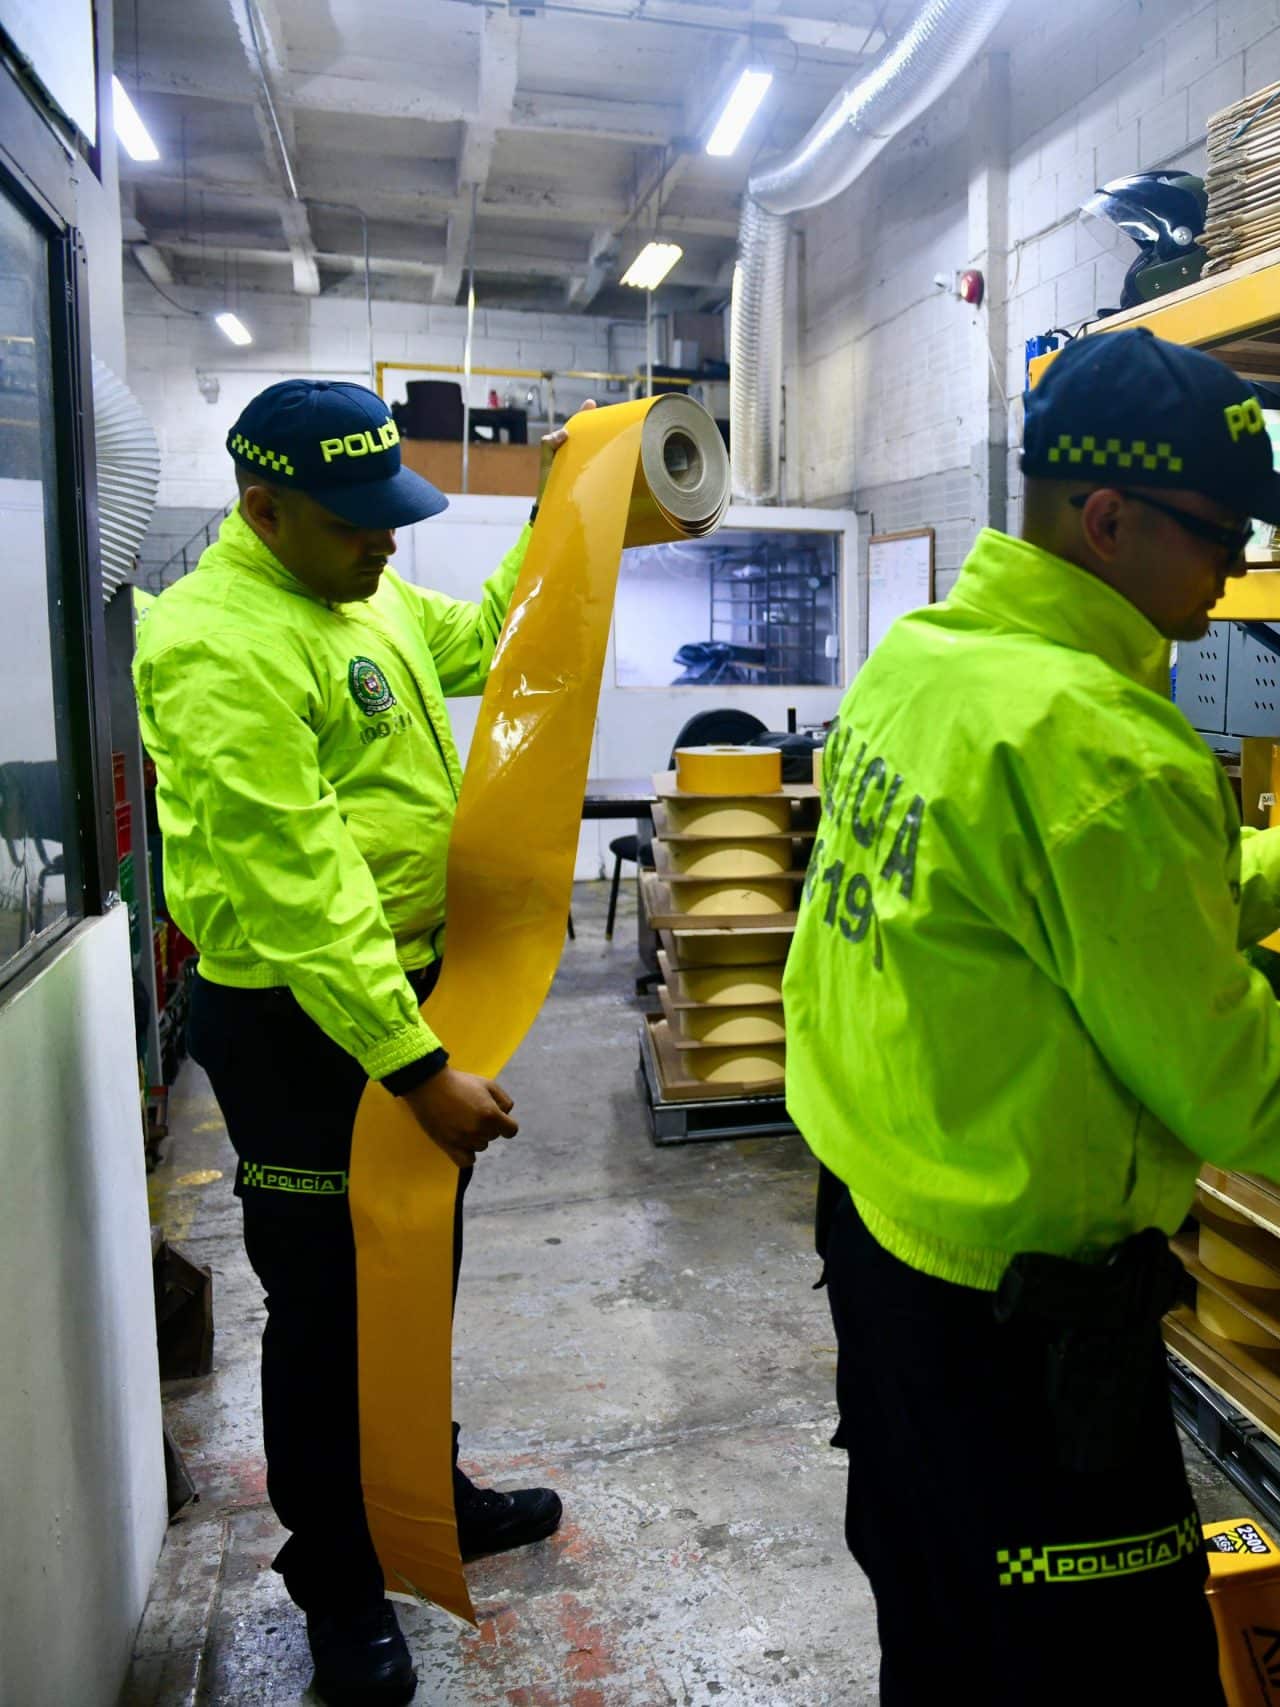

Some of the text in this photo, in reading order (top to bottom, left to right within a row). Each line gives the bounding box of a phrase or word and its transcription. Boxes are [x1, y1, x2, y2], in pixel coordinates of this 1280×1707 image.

[266, 1174, 335, 1191] POLICÍA
[1236, 1525, 1267, 1553] 2500
[1056, 1540, 1173, 1576] POLICÍA
